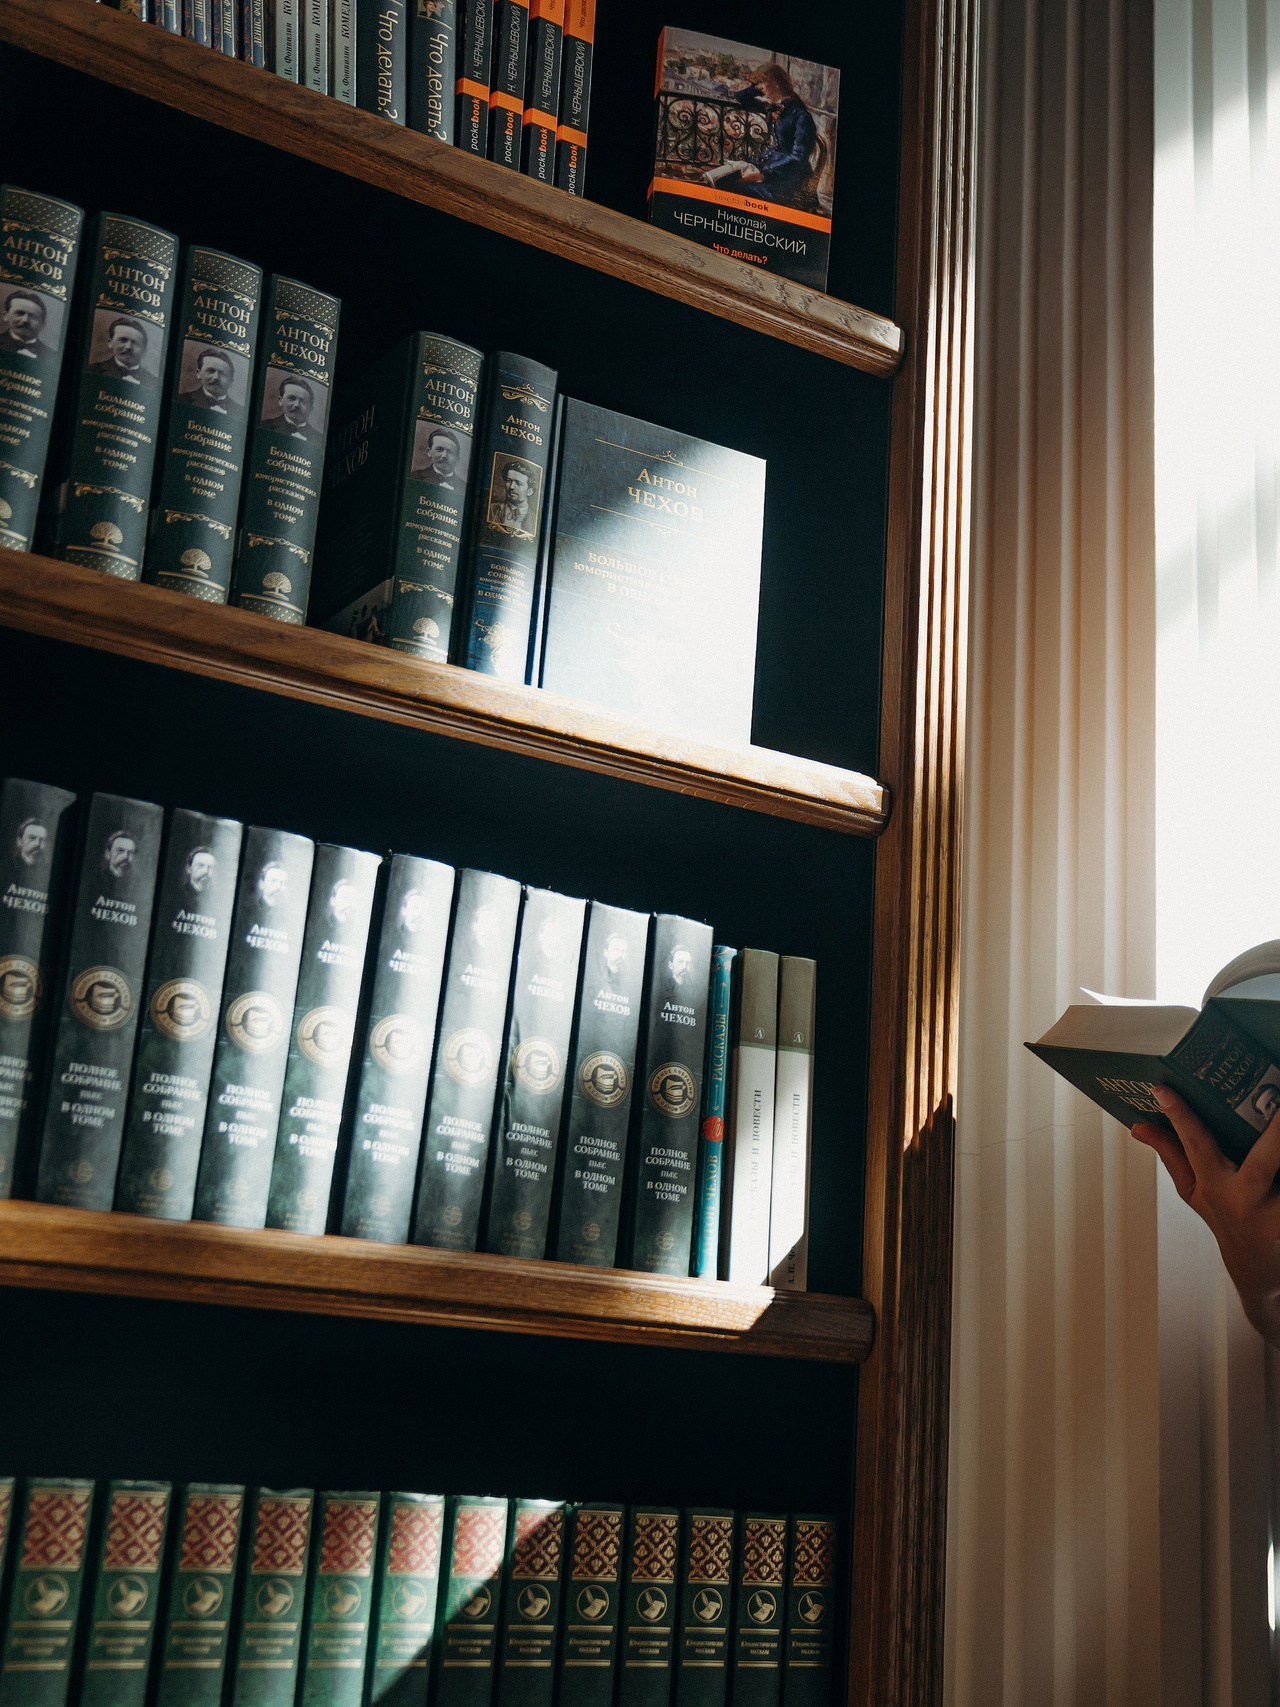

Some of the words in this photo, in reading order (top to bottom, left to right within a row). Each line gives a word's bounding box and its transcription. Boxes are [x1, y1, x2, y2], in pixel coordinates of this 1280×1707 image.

[341, 0, 351, 39] КОМЕД
[378, 10, 399, 41] Что
[284, 22, 292, 64] Фонвизин
[313, 33, 321, 74] Фонвизин
[428, 33, 449, 64] Что
[508, 5, 521, 81] ЧЕРНЫШЕВСКИЙ
[342, 45, 350, 86] Фонвизин
[542, 23, 556, 99] ЧЕРНЫШЕВСКИЙ
[377, 43, 398, 120] делать?
[474, 70, 483, 79] Н.
[572, 41, 586, 116] ЧЕРНЫШЕВСКИЙ
[507, 83, 517, 93] Н.
[427, 65, 448, 141] делать?
[542, 100, 551, 110] Н.
[471, 97, 481, 151] pocketbook
[571, 117, 581, 127] Н.
[504, 110, 514, 164] pocketbook
[538, 127, 548, 180] pocketbook
[717, 209, 767, 231] Николай
[673, 210, 807, 256] ЧЕРНЫШЕВСКИЙ
[2, 235, 69, 266] АНТОН
[713, 242, 730, 255] Что
[730, 249, 768, 265] делать?
[6, 252, 63, 281] ЧЕХОВ
[105, 263, 166, 293] АНТОН
[108, 279, 161, 307] ЧЕХОВ
[193, 295, 250, 324] АНТОН
[196, 311, 247, 339] ЧЕХОВ
[276, 324, 330, 353] АНТОН
[279, 340, 326, 367] ЧЕХОВ
[0, 368, 42, 387] ольшое
[98, 390, 146, 413] Большое
[425, 378, 475, 405] АНТОН
[94, 403, 146, 424] собрание
[427, 393, 472, 419] ЧЕХОВ
[187, 419, 233, 442] Большое
[507, 414, 541, 433] Антон
[184, 432, 233, 453] собрание
[501, 424, 543, 446] ЧЕХОВ
[102, 458, 129, 472] томе
[103, 448, 137, 464] одном
[269, 445, 312, 468] Большое
[266, 458, 312, 479] собрание
[191, 486, 216, 499] томе
[192, 476, 225, 492] одном
[636, 468, 698, 499] Антон
[274, 501, 304, 517] одном
[419, 495, 458, 516] Большое
[627, 485, 705, 522] ЧЕХОВ
[273, 510, 297, 524] томе
[416, 507, 458, 527] собрание
[418, 533, 453, 549] рассказов
[422, 559, 444, 571] томе
[423, 548, 451, 564] одном
[91, 907, 138, 927] ЧЕХОВ
[172, 920, 218, 939] ЧЕХОВ
[593, 999, 631, 1016] ЧЕХОВ
[596, 989, 630, 1005] Антон
[663, 1001, 696, 1015] Антон
[660, 1011, 697, 1027] ЧЕХОВ
[711, 1013, 727, 1082] РАССКАЗЫ
[1209, 1041, 1246, 1087] АНТОН
[1119, 1095, 1165, 1114] ЧЕХО
[442, 1115, 483, 1133] ПОЛНОЕ
[752, 1089, 763, 1143] ПОВЕСТИ
[791, 1093, 801, 1147] ПОВЕСТИ
[435, 1124, 486, 1144] СОБРАНИЕ
[505, 1131, 553, 1149] СОБРАНИЕ
[512, 1122, 551, 1138] ПОЛНОЕ
[573, 1144, 621, 1161] СОБРАНИЕ
[579, 1135, 618, 1151] ПОЛНОЕ
[650, 1146, 689, 1161] ПОЛНОЕ
[436, 1150, 445, 1162] В
[445, 1151, 480, 1169] ОДНОМ
[445, 1161, 472, 1176] ТОМЕ
[505, 1157, 514, 1167] В
[514, 1158, 548, 1174] ОДНОМ
[645, 1156, 692, 1171] СОБРАНИЕ
[514, 1167, 541, 1182] ТОМЕ
[574, 1169, 582, 1179] В
[582, 1170, 616, 1185] ОДНОМ
[704, 1154, 718, 1202] ЧЕХОВ
[582, 1180, 608, 1194] ТОМЕ
[647, 1180, 655, 1190] В
[654, 1181, 688, 1195] ОДНОМ
[654, 1190, 681, 1203] ТОМЕ
